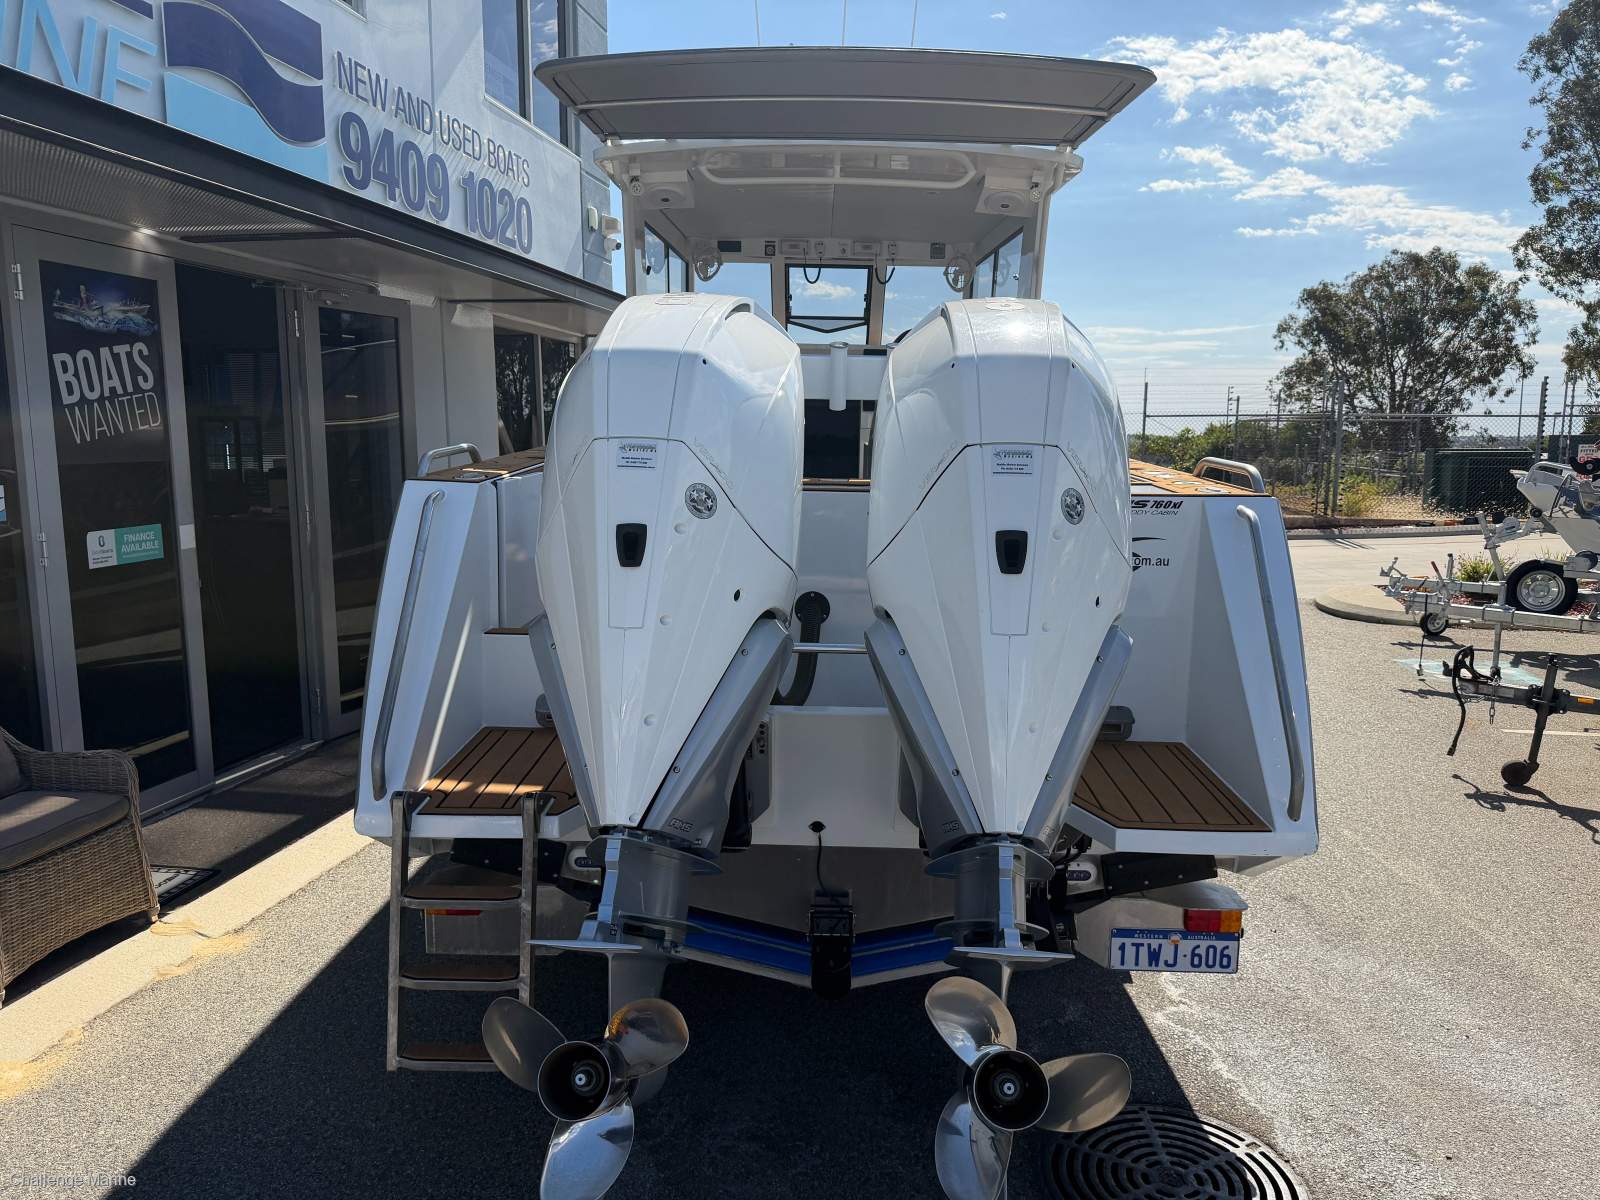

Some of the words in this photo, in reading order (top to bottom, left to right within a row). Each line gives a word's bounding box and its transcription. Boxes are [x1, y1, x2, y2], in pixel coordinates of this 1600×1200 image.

[336, 50, 389, 112] NEW
[394, 86, 433, 135] AND
[439, 110, 482, 161] USED
[487, 138, 530, 188] BOATS
[339, 111, 450, 221] 9409
[461, 171, 533, 254] 1020
[52, 341, 154, 405] BOATS
[65, 392, 161, 444] WANTED
[121, 540, 160, 553] AVAILABLE
[123, 531, 155, 542] FINANCE
[1133, 557, 1170, 567] om.au
